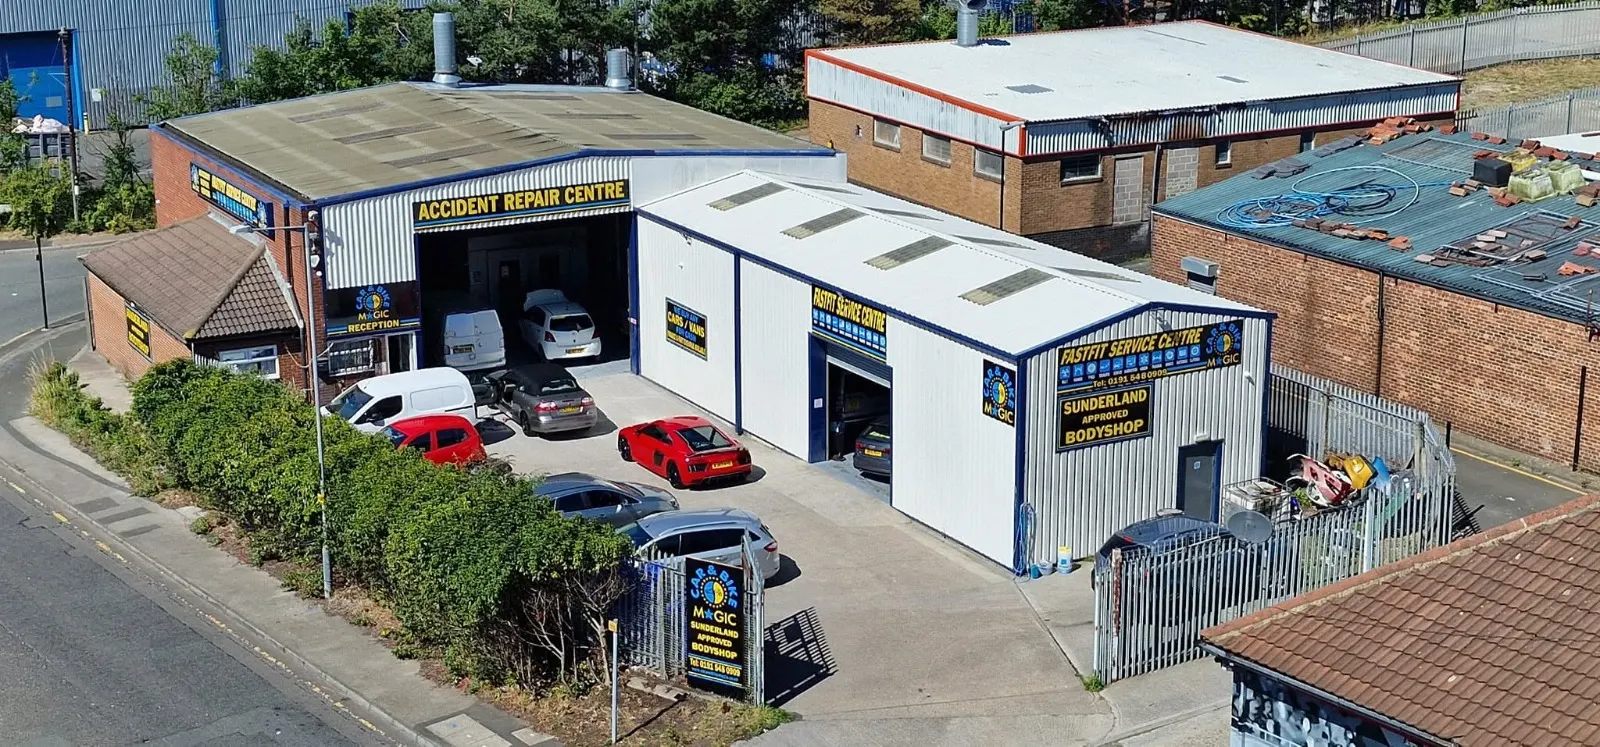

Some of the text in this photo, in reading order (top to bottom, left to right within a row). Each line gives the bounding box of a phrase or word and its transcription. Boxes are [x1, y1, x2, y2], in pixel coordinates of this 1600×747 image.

[419, 181, 625, 221] ACCIDENT REPAIR CENTRE
[356, 289, 368, 310] CAR
[376, 285, 391, 308] BIKE
[813, 286, 886, 333] FASTFIT SERVICE CENTRE
[348, 319, 400, 333] RECEPTION
[668, 311, 684, 328] CARS
[689, 320, 705, 338] VANS
[1060, 327, 1204, 365] FASTFIT SERVICE CENTRE
[1206, 322, 1241, 354] CAR & BIKE
[983, 366, 1015, 409] CAR & BIKE
[1093, 379, 1107, 388] Tel:
[1107, 375, 1129, 385] 0191
[1063, 389, 1148, 415] SUNDERLAND
[1082, 409, 1129, 425] APPROVED
[1065, 419, 1144, 445] BODYSHOP
[690, 564, 738, 609] CAR & BIKE
[690, 620, 739, 639] SUNDERLAND
[697, 633, 732, 647] APPROVED
[691, 642, 738, 659] BODYSHOP
